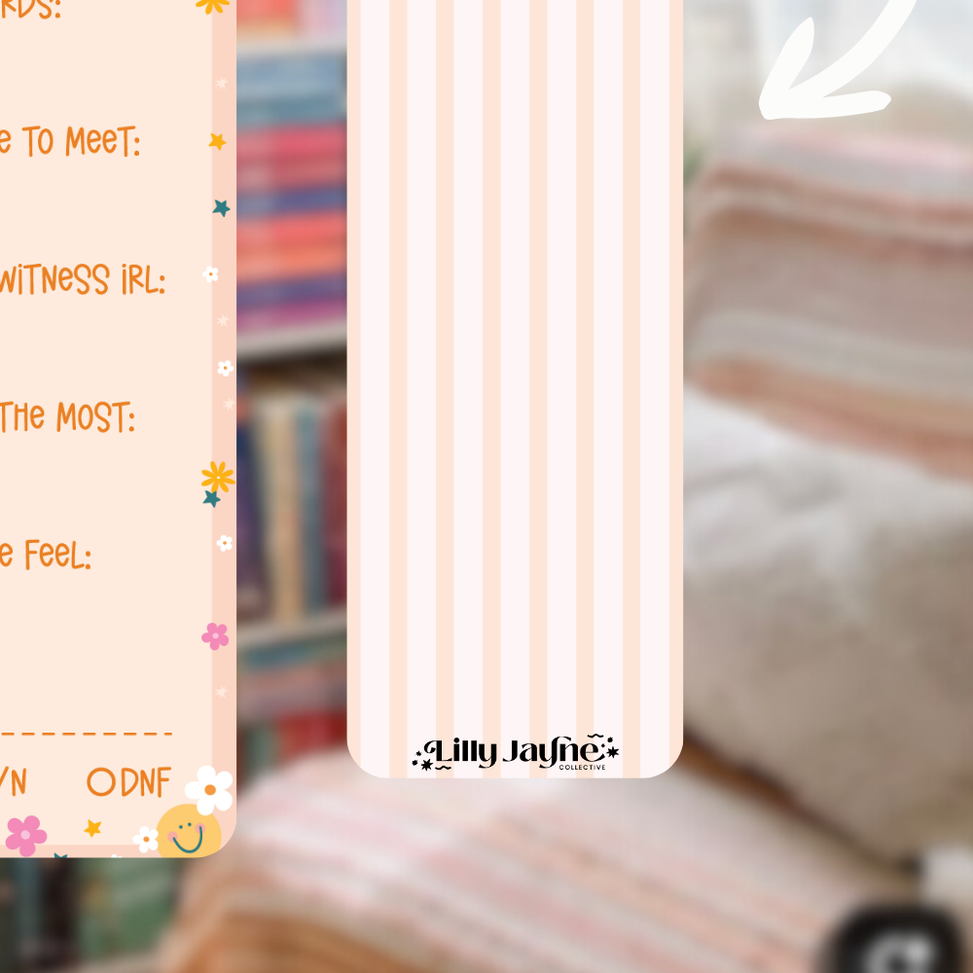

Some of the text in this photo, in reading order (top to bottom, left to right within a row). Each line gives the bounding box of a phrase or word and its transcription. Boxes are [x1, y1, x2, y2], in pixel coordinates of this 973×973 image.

[21, 125, 54, 158] TO
[56, 401, 135, 434] MOST:
[423, 735, 606, 769] Lilly Jayne
[120, 766, 172, 799] DNF
